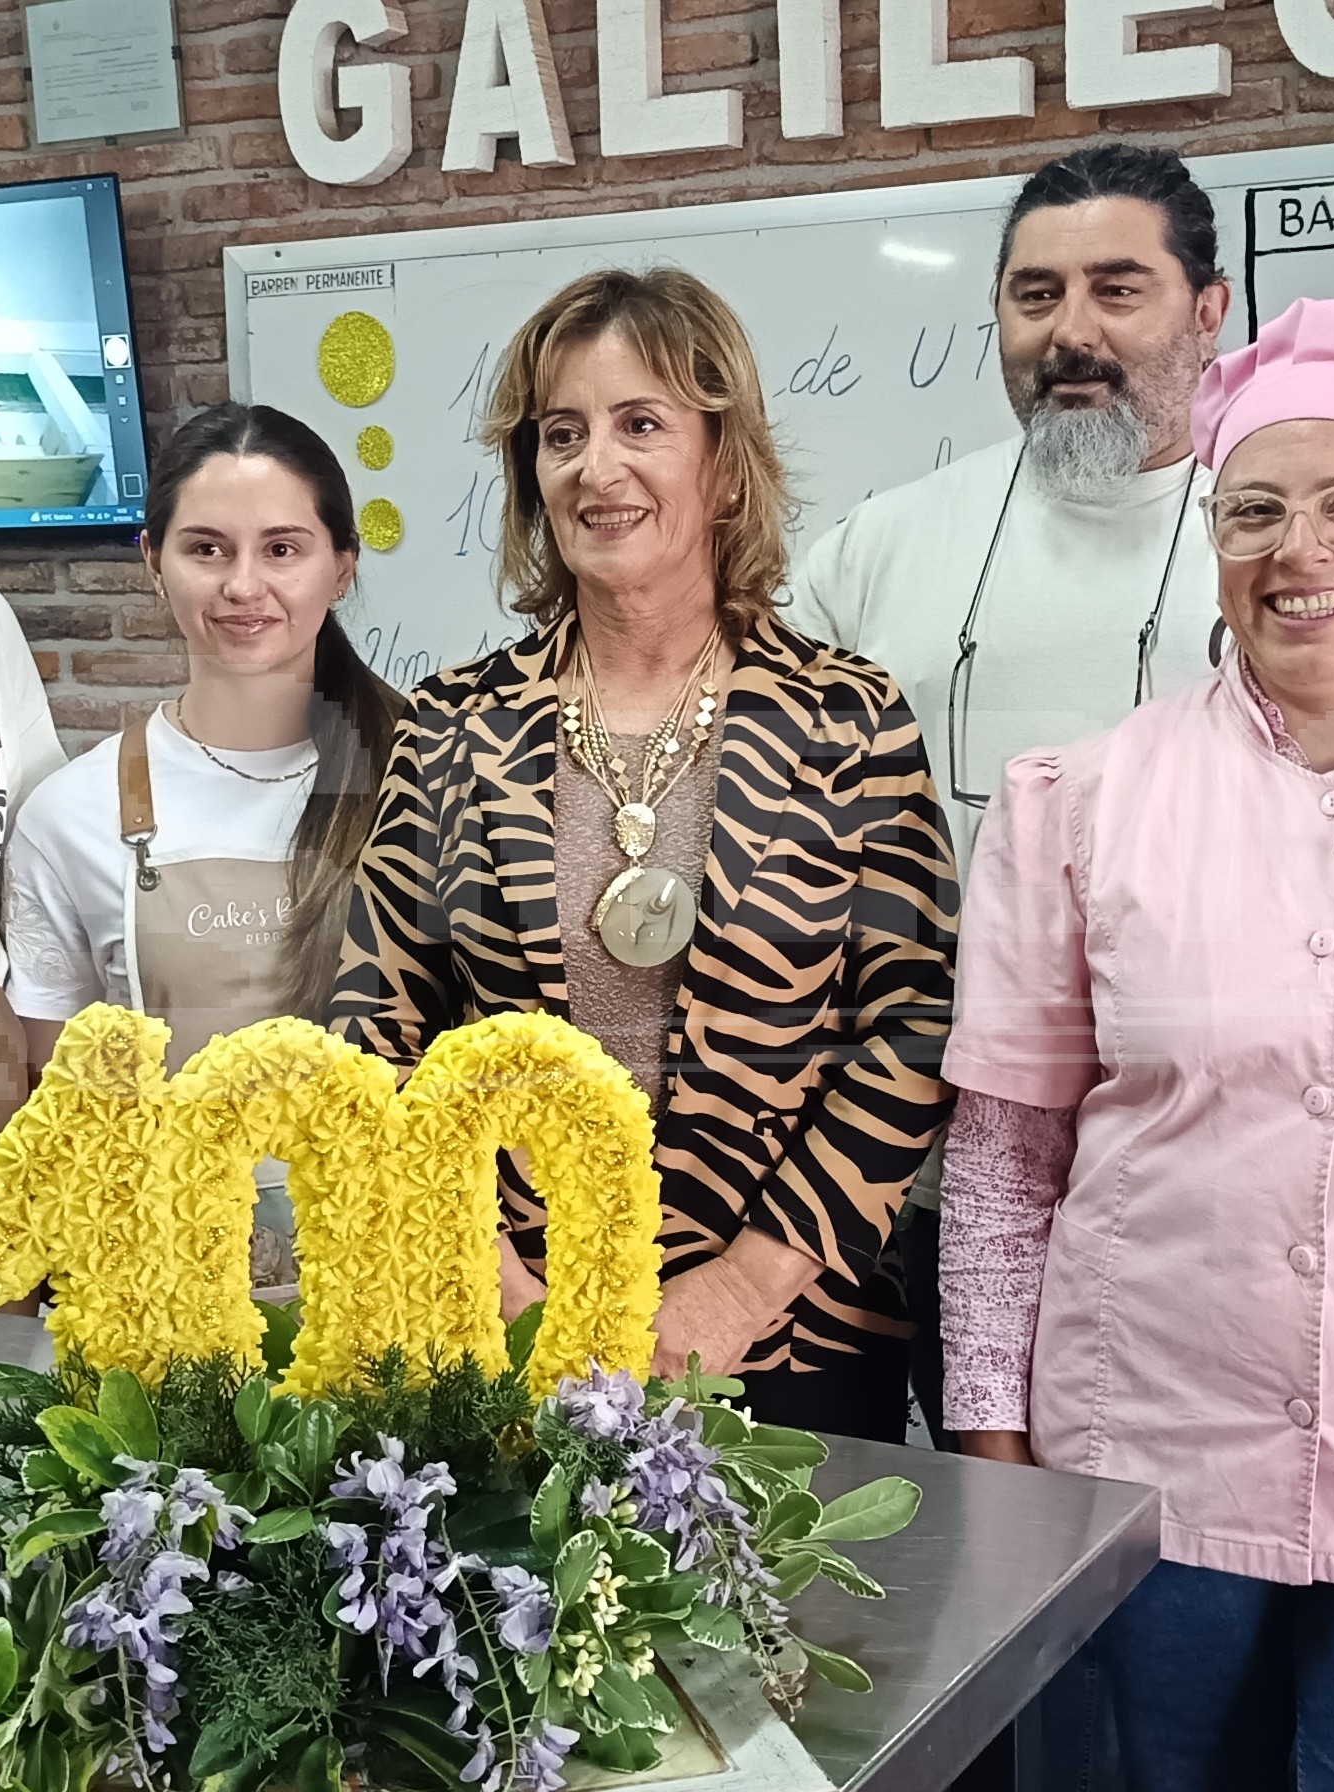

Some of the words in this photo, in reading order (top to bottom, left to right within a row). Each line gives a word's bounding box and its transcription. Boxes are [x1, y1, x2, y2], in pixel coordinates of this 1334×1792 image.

[252, 277, 298, 296] BARREN
[306, 269, 384, 290] PERMANENTE
[773, 324, 862, 396] de
[187, 901, 271, 938] Cake's
